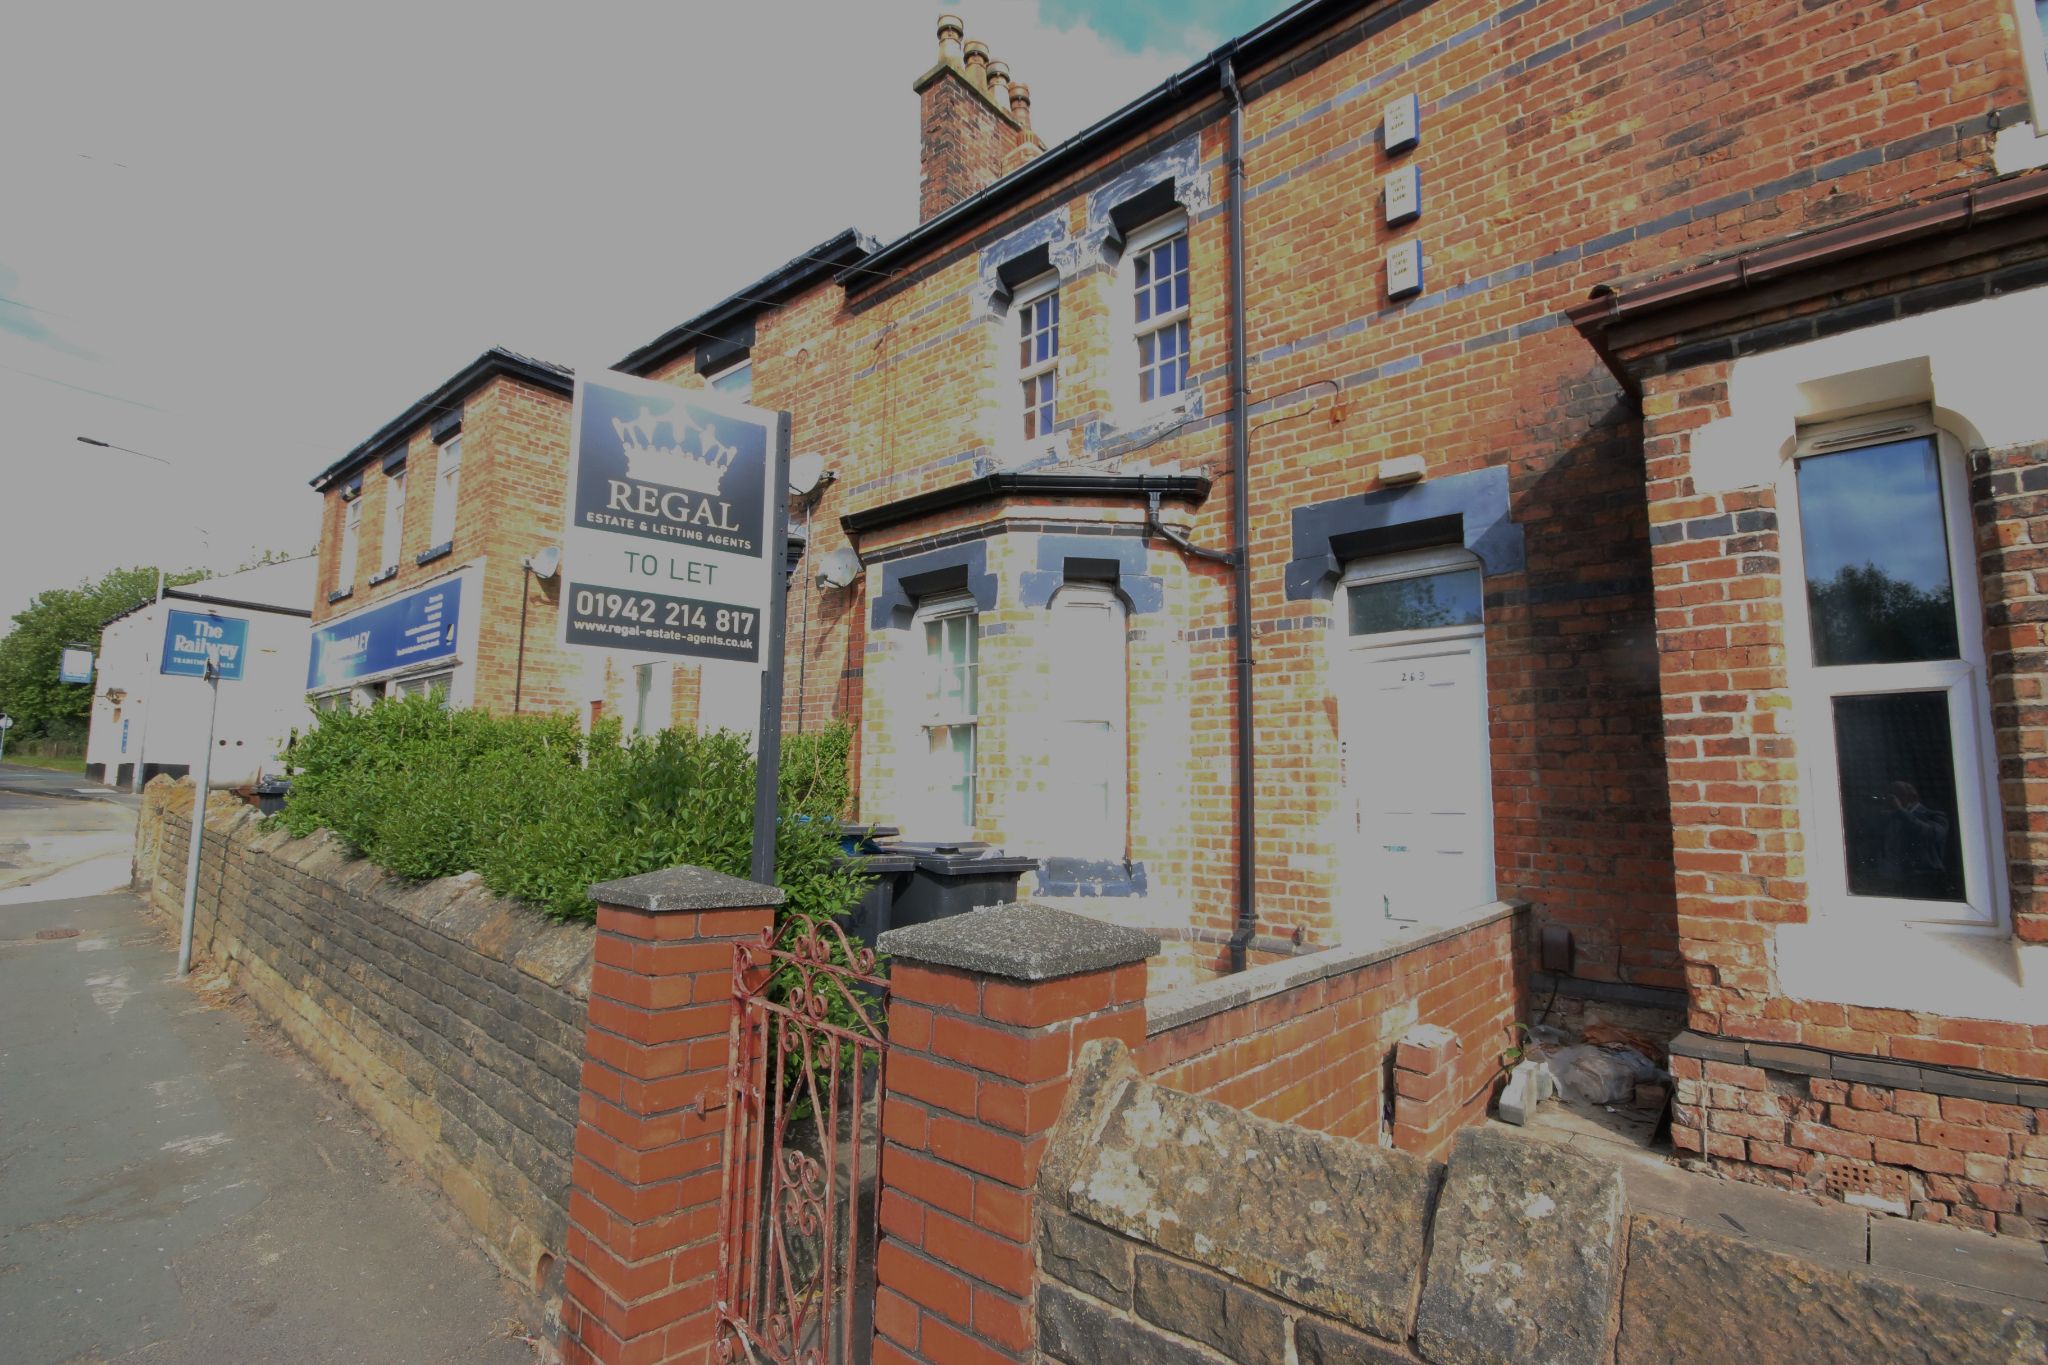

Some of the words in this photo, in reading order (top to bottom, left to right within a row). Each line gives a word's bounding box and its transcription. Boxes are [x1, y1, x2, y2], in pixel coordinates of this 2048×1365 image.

[606, 480, 739, 531] REGAL
[587, 513, 634, 529] ESTATE
[639, 521, 648, 532] &
[653, 523, 703, 541] LETTING
[707, 533, 752, 550] AGENTS
[624, 551, 658, 576] TO
[670, 558, 718, 585] LET
[576, 590, 656, 623] 01942
[665, 602, 707, 630] 214
[716, 609, 755, 635] 817
[194, 621, 223, 638] The
[574, 621, 752, 649] www.regal-estate-agents.co.uk
[174, 635, 240, 660] Railway
[1401, 671, 1425, 682] 263
